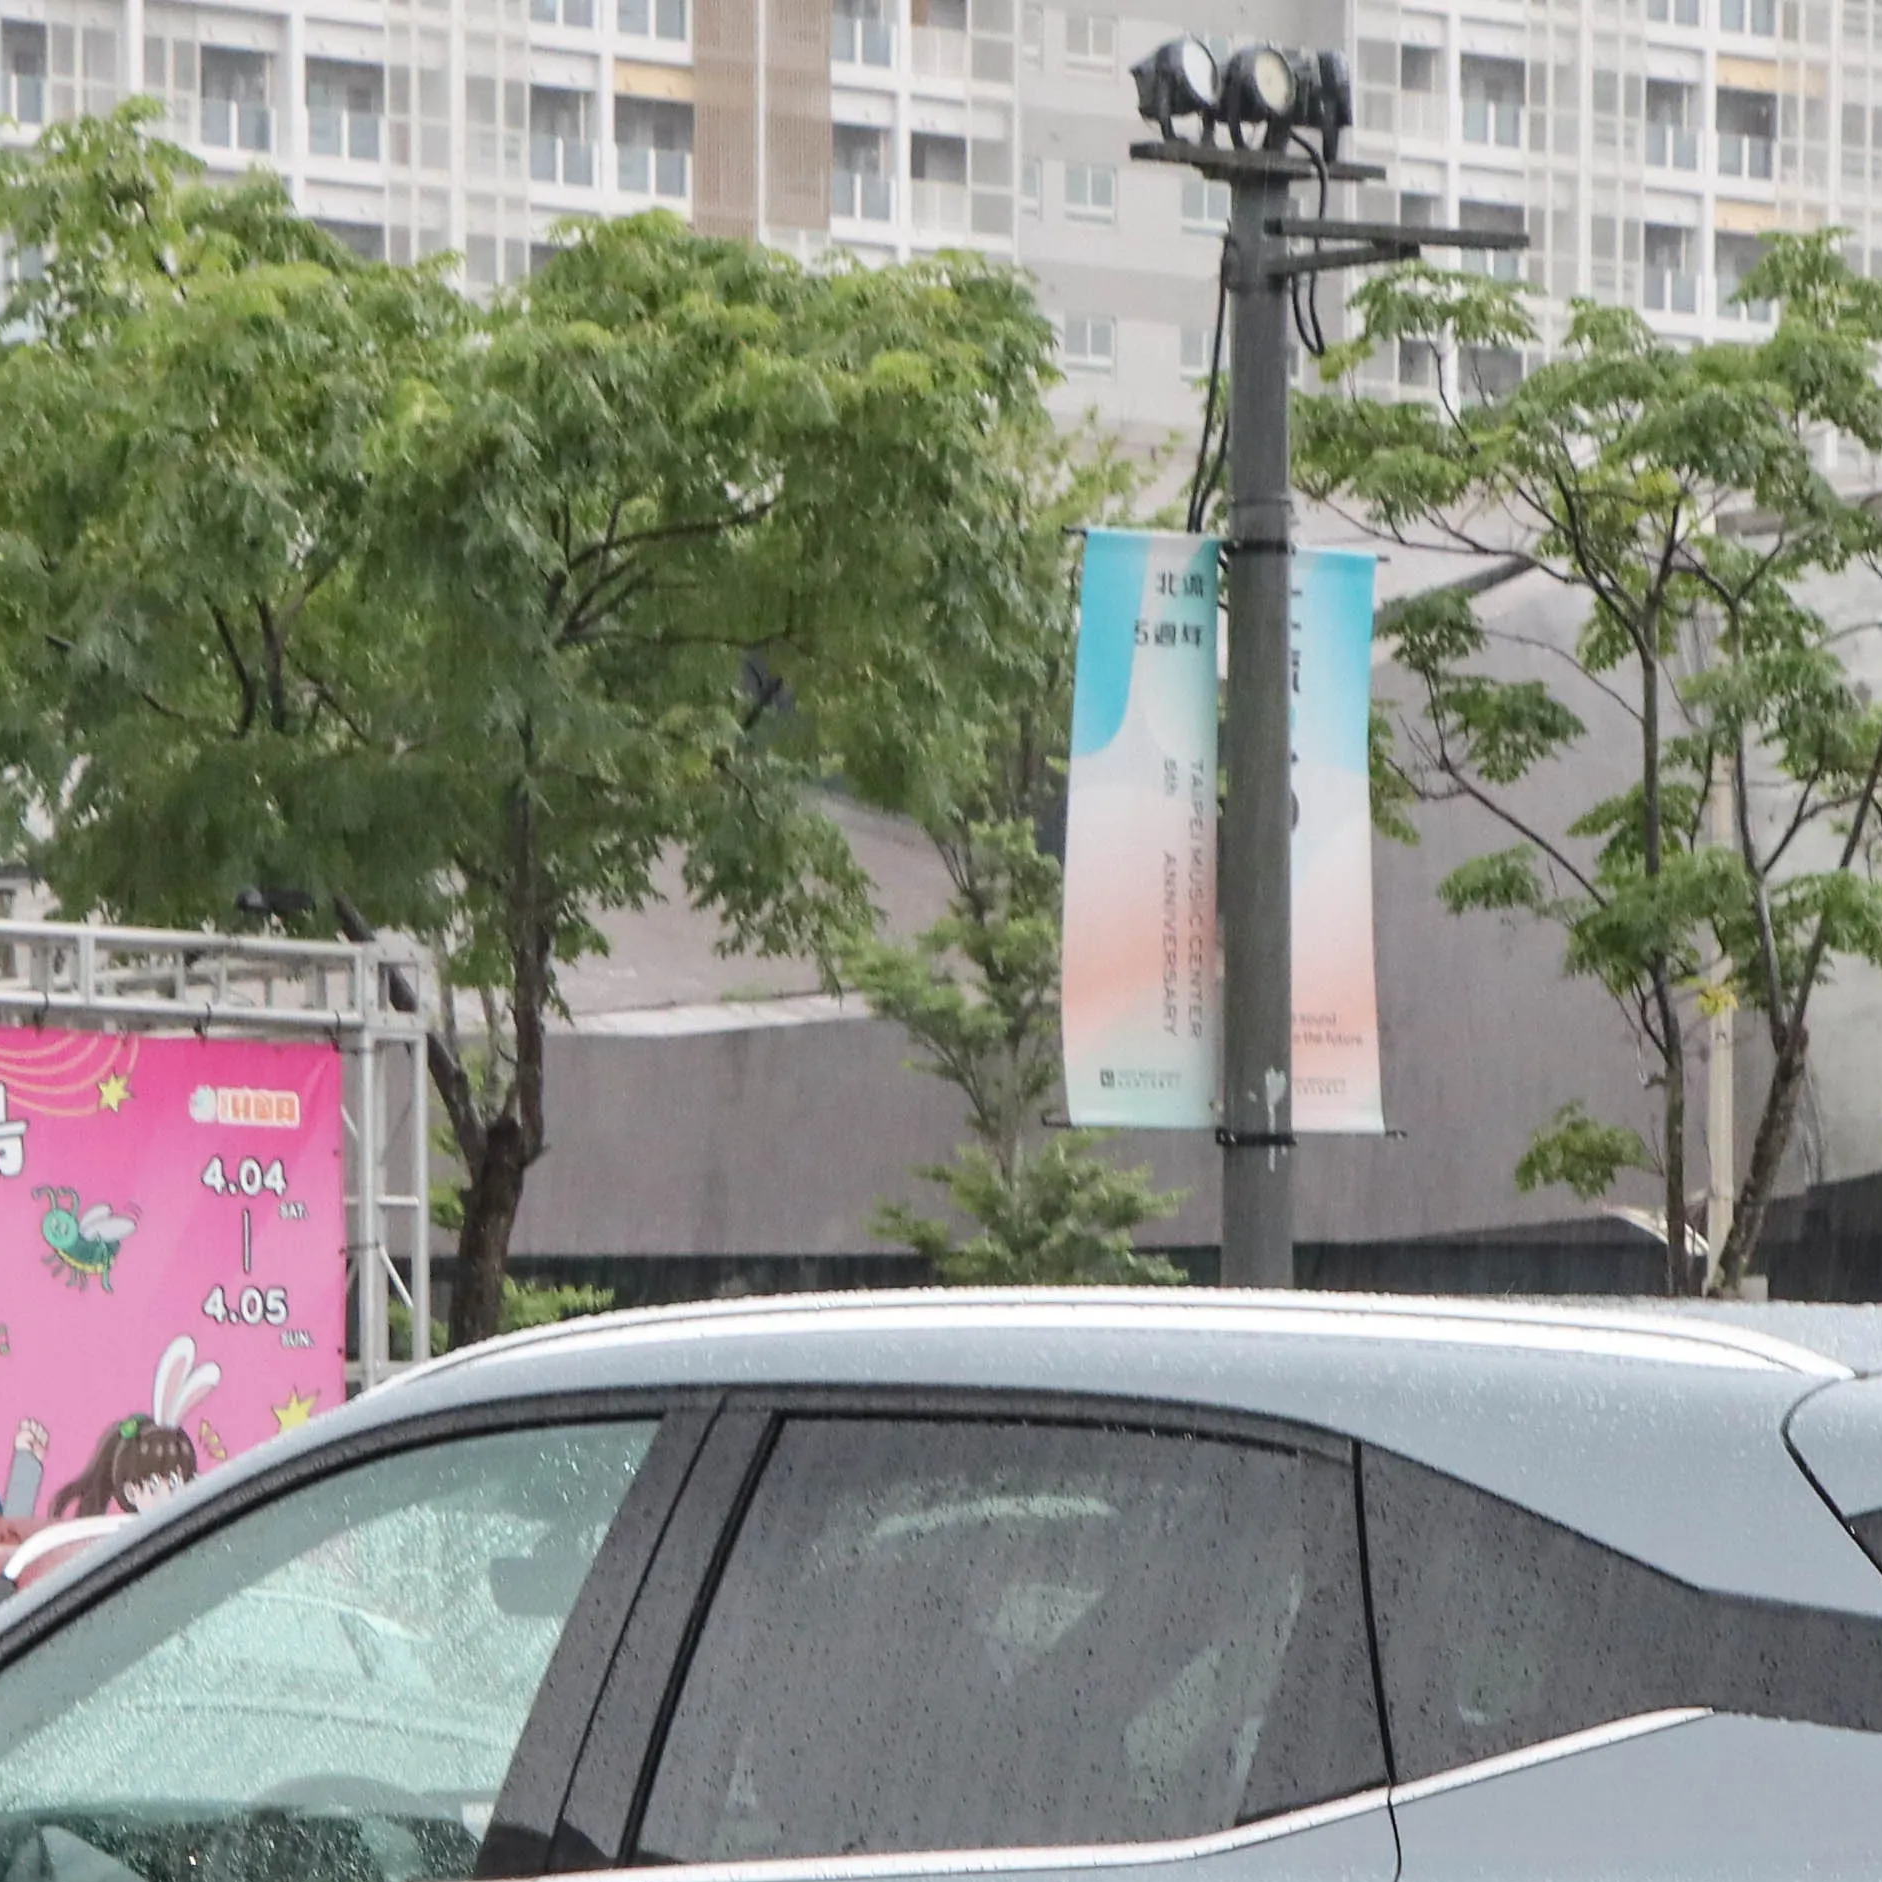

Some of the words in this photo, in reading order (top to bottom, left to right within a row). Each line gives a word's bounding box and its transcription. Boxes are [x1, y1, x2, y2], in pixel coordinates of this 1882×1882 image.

[1188, 846, 1205, 928] MUSIC
[1188, 935, 1206, 1041] CENTER
[201, 1154, 287, 1197] 4.04
[202, 1283, 289, 1327] 4.05
